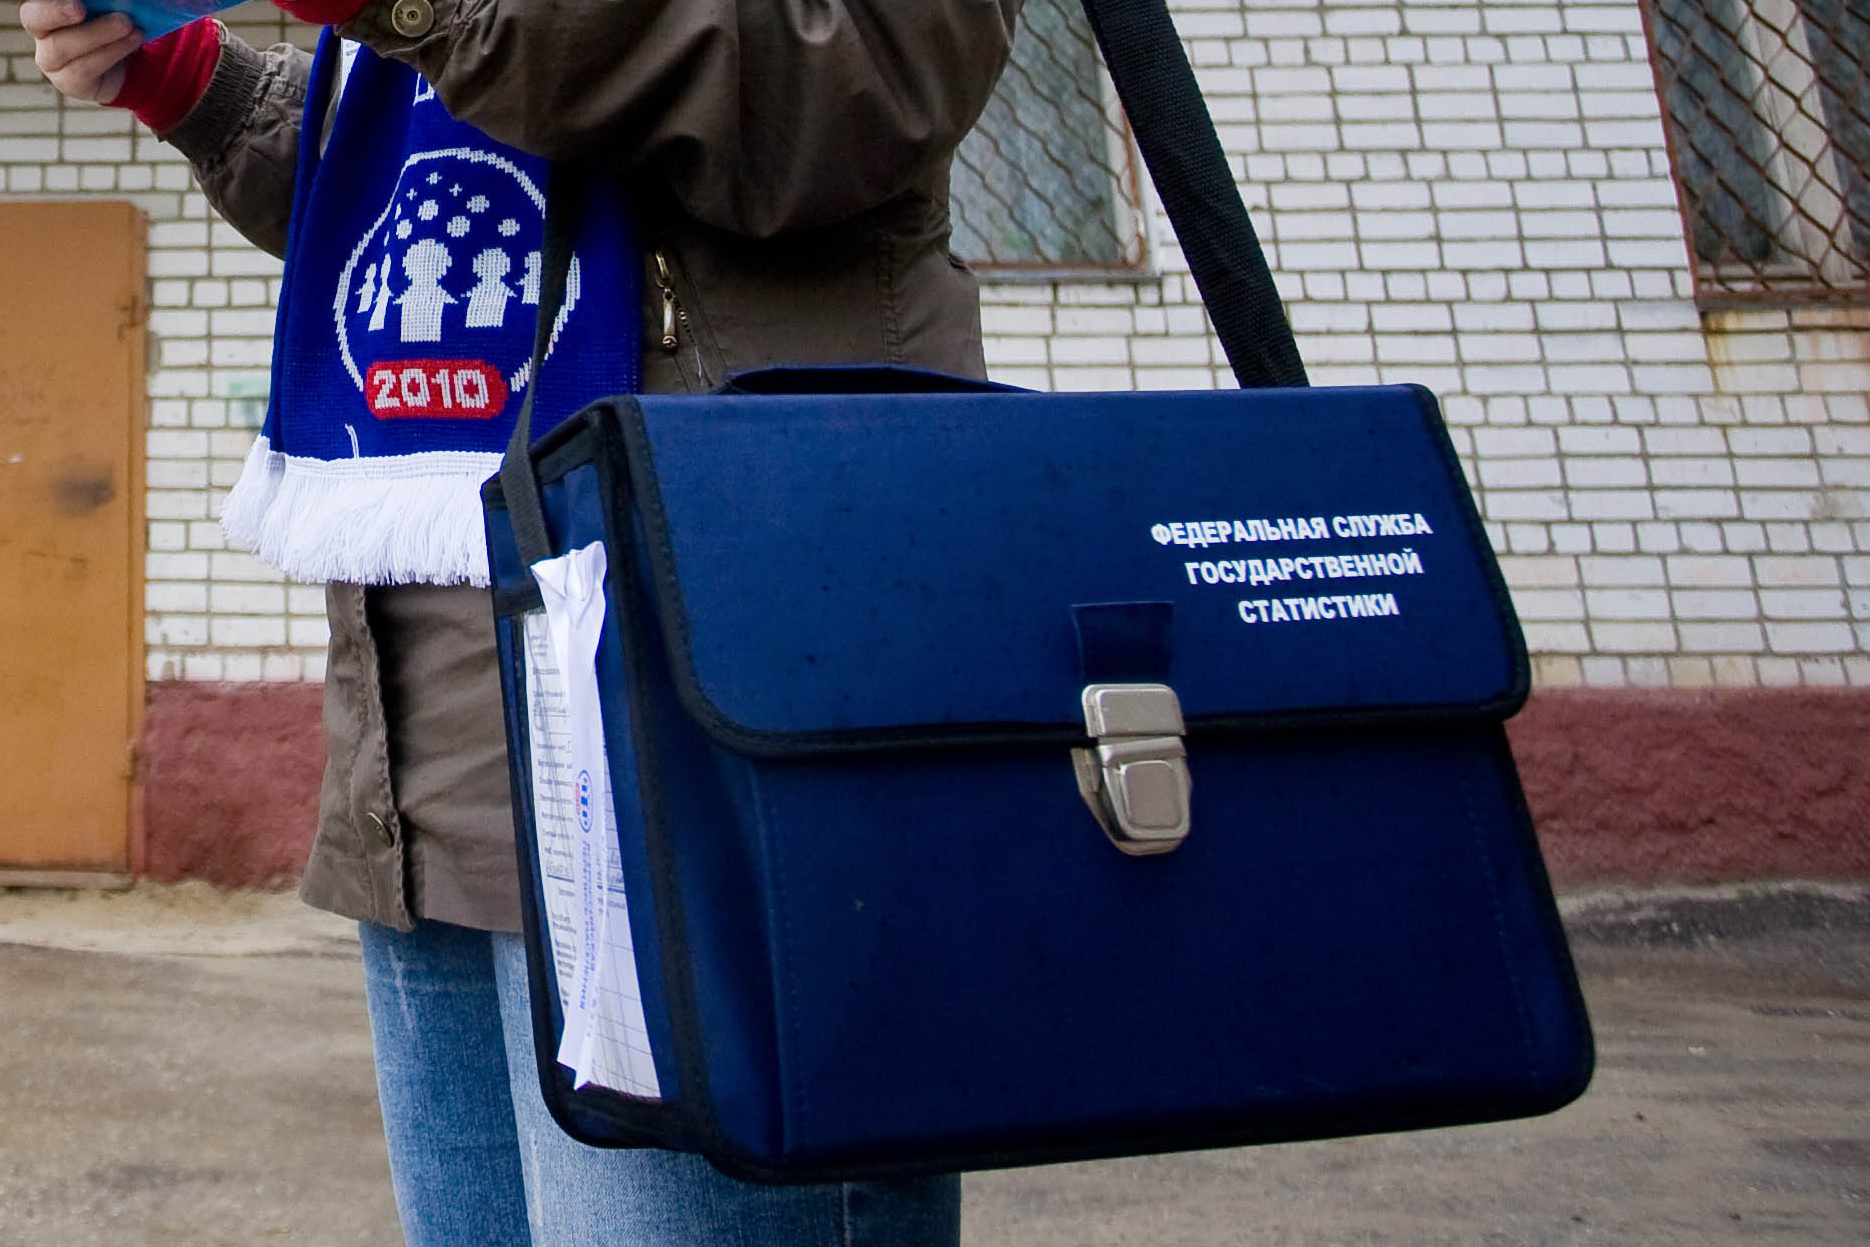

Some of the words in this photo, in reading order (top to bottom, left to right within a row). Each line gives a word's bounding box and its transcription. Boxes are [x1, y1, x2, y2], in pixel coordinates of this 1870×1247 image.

[373, 368, 490, 410] 2010
[1150, 516, 1330, 548] ФЕДЕРАЛЬНАЯ
[1332, 513, 1434, 539] СЛУЖБА
[1184, 548, 1425, 586] ГОСУДАРСТВЕННОЙ
[1238, 593, 1401, 624] СТАТИСТИКИ
